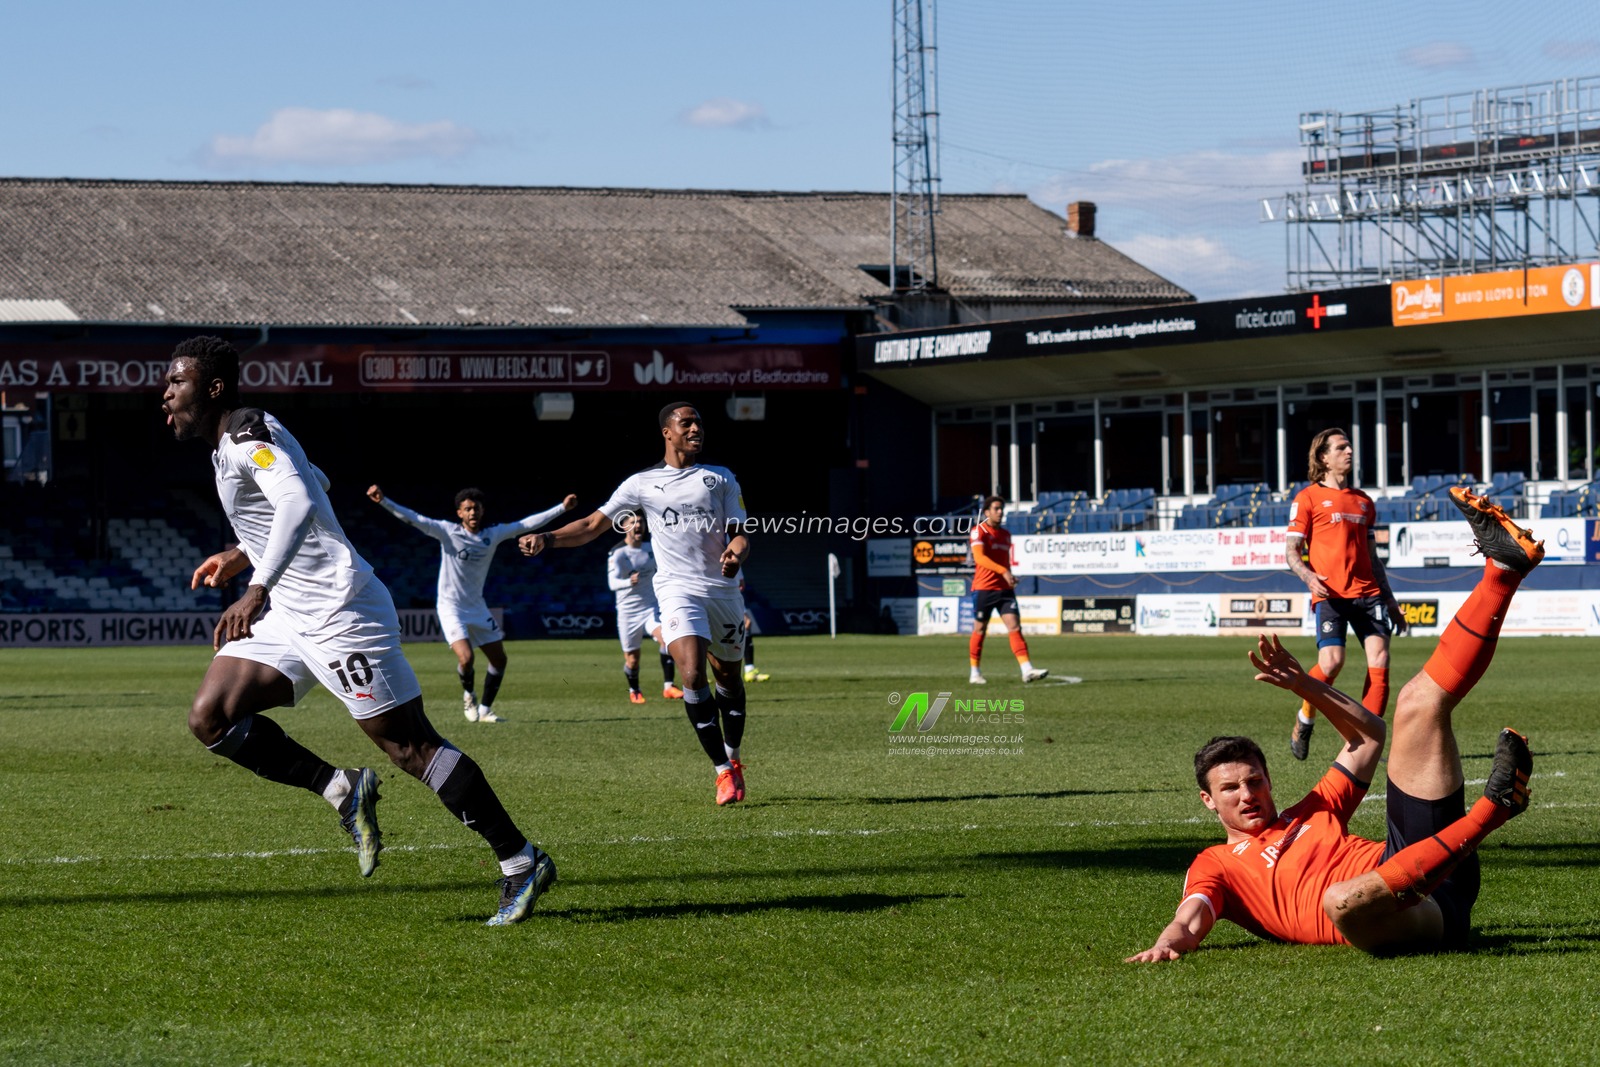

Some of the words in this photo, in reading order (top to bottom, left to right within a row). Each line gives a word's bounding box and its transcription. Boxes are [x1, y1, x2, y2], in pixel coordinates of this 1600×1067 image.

[1454, 290, 1483, 304] DAVID
[1485, 287, 1514, 302] LLOYD
[1235, 308, 1296, 329] niceic.com
[1026, 331, 1039, 344] The
[1054, 329, 1078, 342] number
[1079, 329, 1091, 340] one
[1092, 325, 1113, 339] choice
[1113, 324, 1124, 337] for
[1124, 320, 1157, 338] registered
[1157, 317, 1196, 333] electricians
[875, 338, 910, 363] LIGHTING
[920, 336, 935, 359] THE
[935, 330, 991, 357] CHAMPIONSHIP
[46, 360, 69, 386] A
[365, 357, 394, 380] 0300
[397, 357, 426, 380] 3300
[429, 357, 451, 379] 073
[460, 356, 564, 379] WWW.BEDS.AC.UK
[674, 370, 735, 385] University
[738, 370, 750, 383] of
[752, 369, 829, 384] Bedfordshire
[1024, 538, 1045, 553] Civil
[1048, 538, 1107, 558] Engineering
[1110, 536, 1126, 552] Ltd
[1218, 532, 1231, 545] For
[1235, 531, 1245, 544] all
[1248, 533, 1267, 547] your
[1232, 552, 1247, 565] and
[1251, 551, 1270, 565] Print
[1084, 599, 1096, 608] THE
[1270, 600, 1288, 612] BBQ
[1063, 610, 1083, 621] GREAT
[1084, 609, 1117, 620] NORTHERN
[1073, 623, 1088, 632] FREE
[1088, 623, 1105, 632] HOUSE
[328, 652, 374, 694] 10
